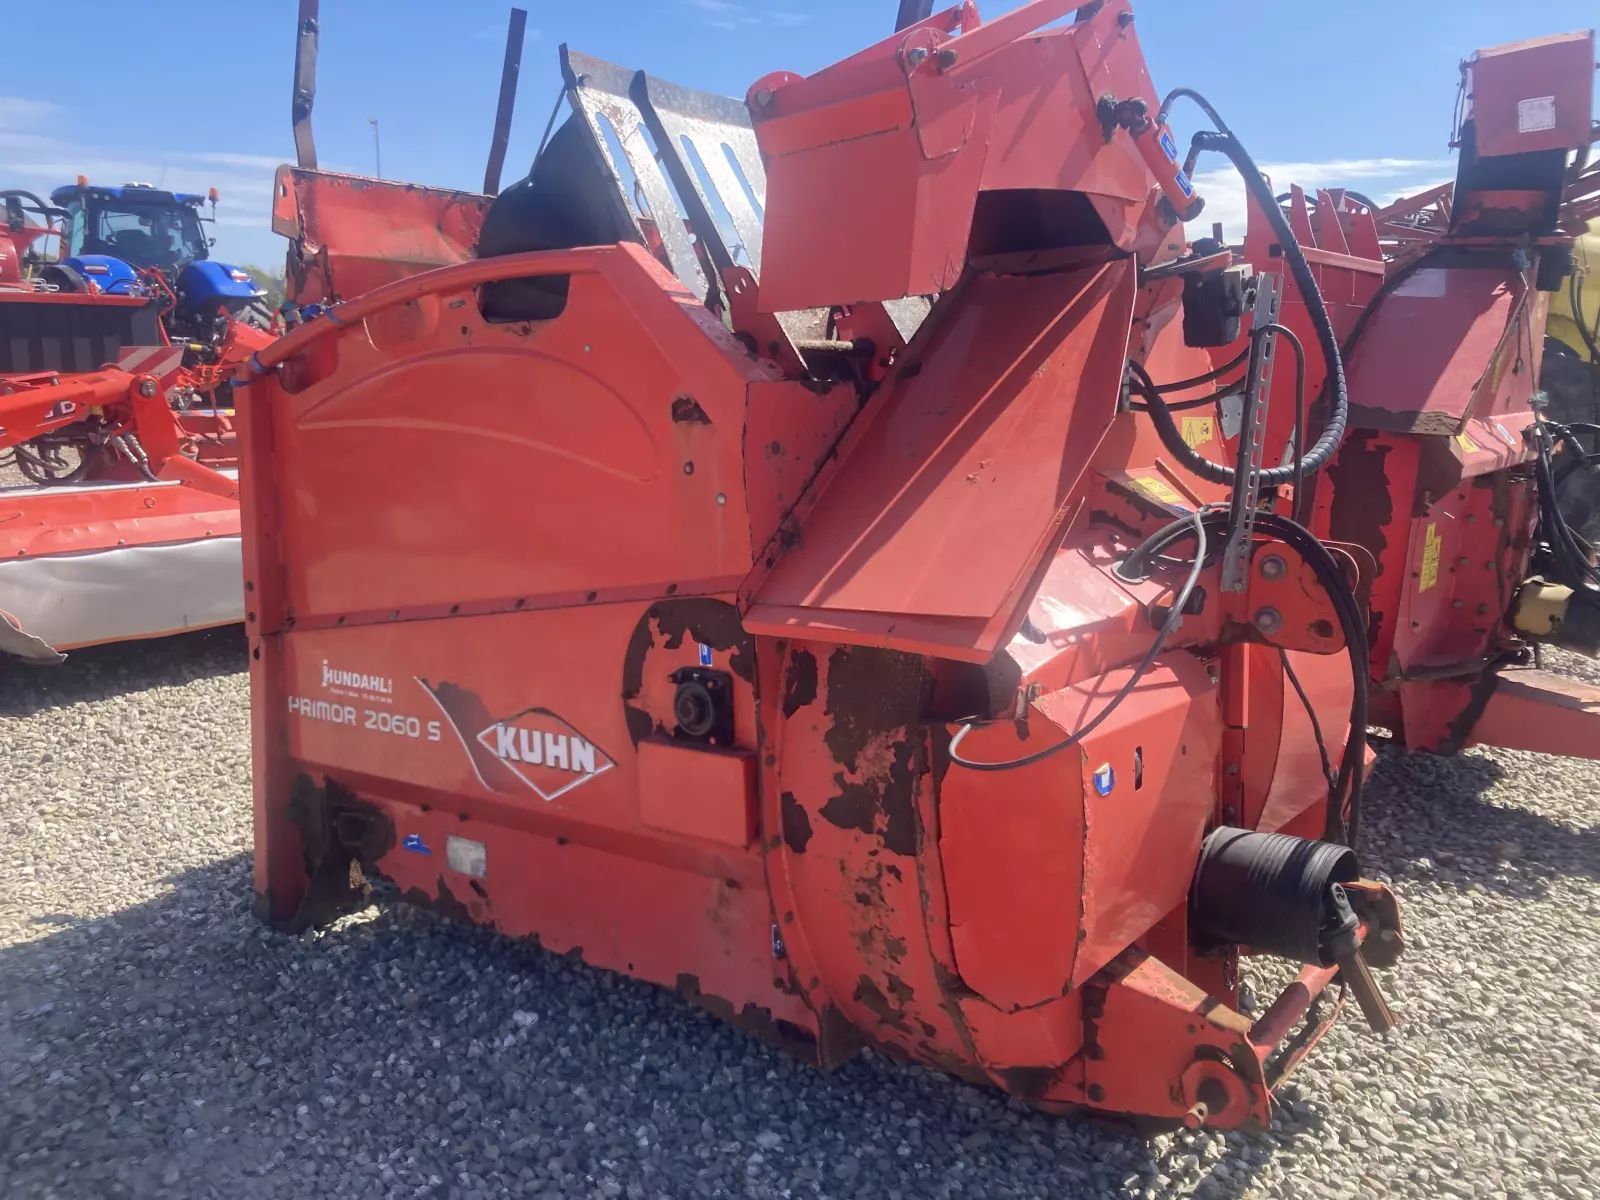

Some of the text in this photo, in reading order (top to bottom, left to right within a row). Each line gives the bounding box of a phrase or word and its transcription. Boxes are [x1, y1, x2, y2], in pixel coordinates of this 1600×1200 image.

[288, 696, 442, 742] PRIMOR 2060 S
[496, 722, 597, 774] KUHN
